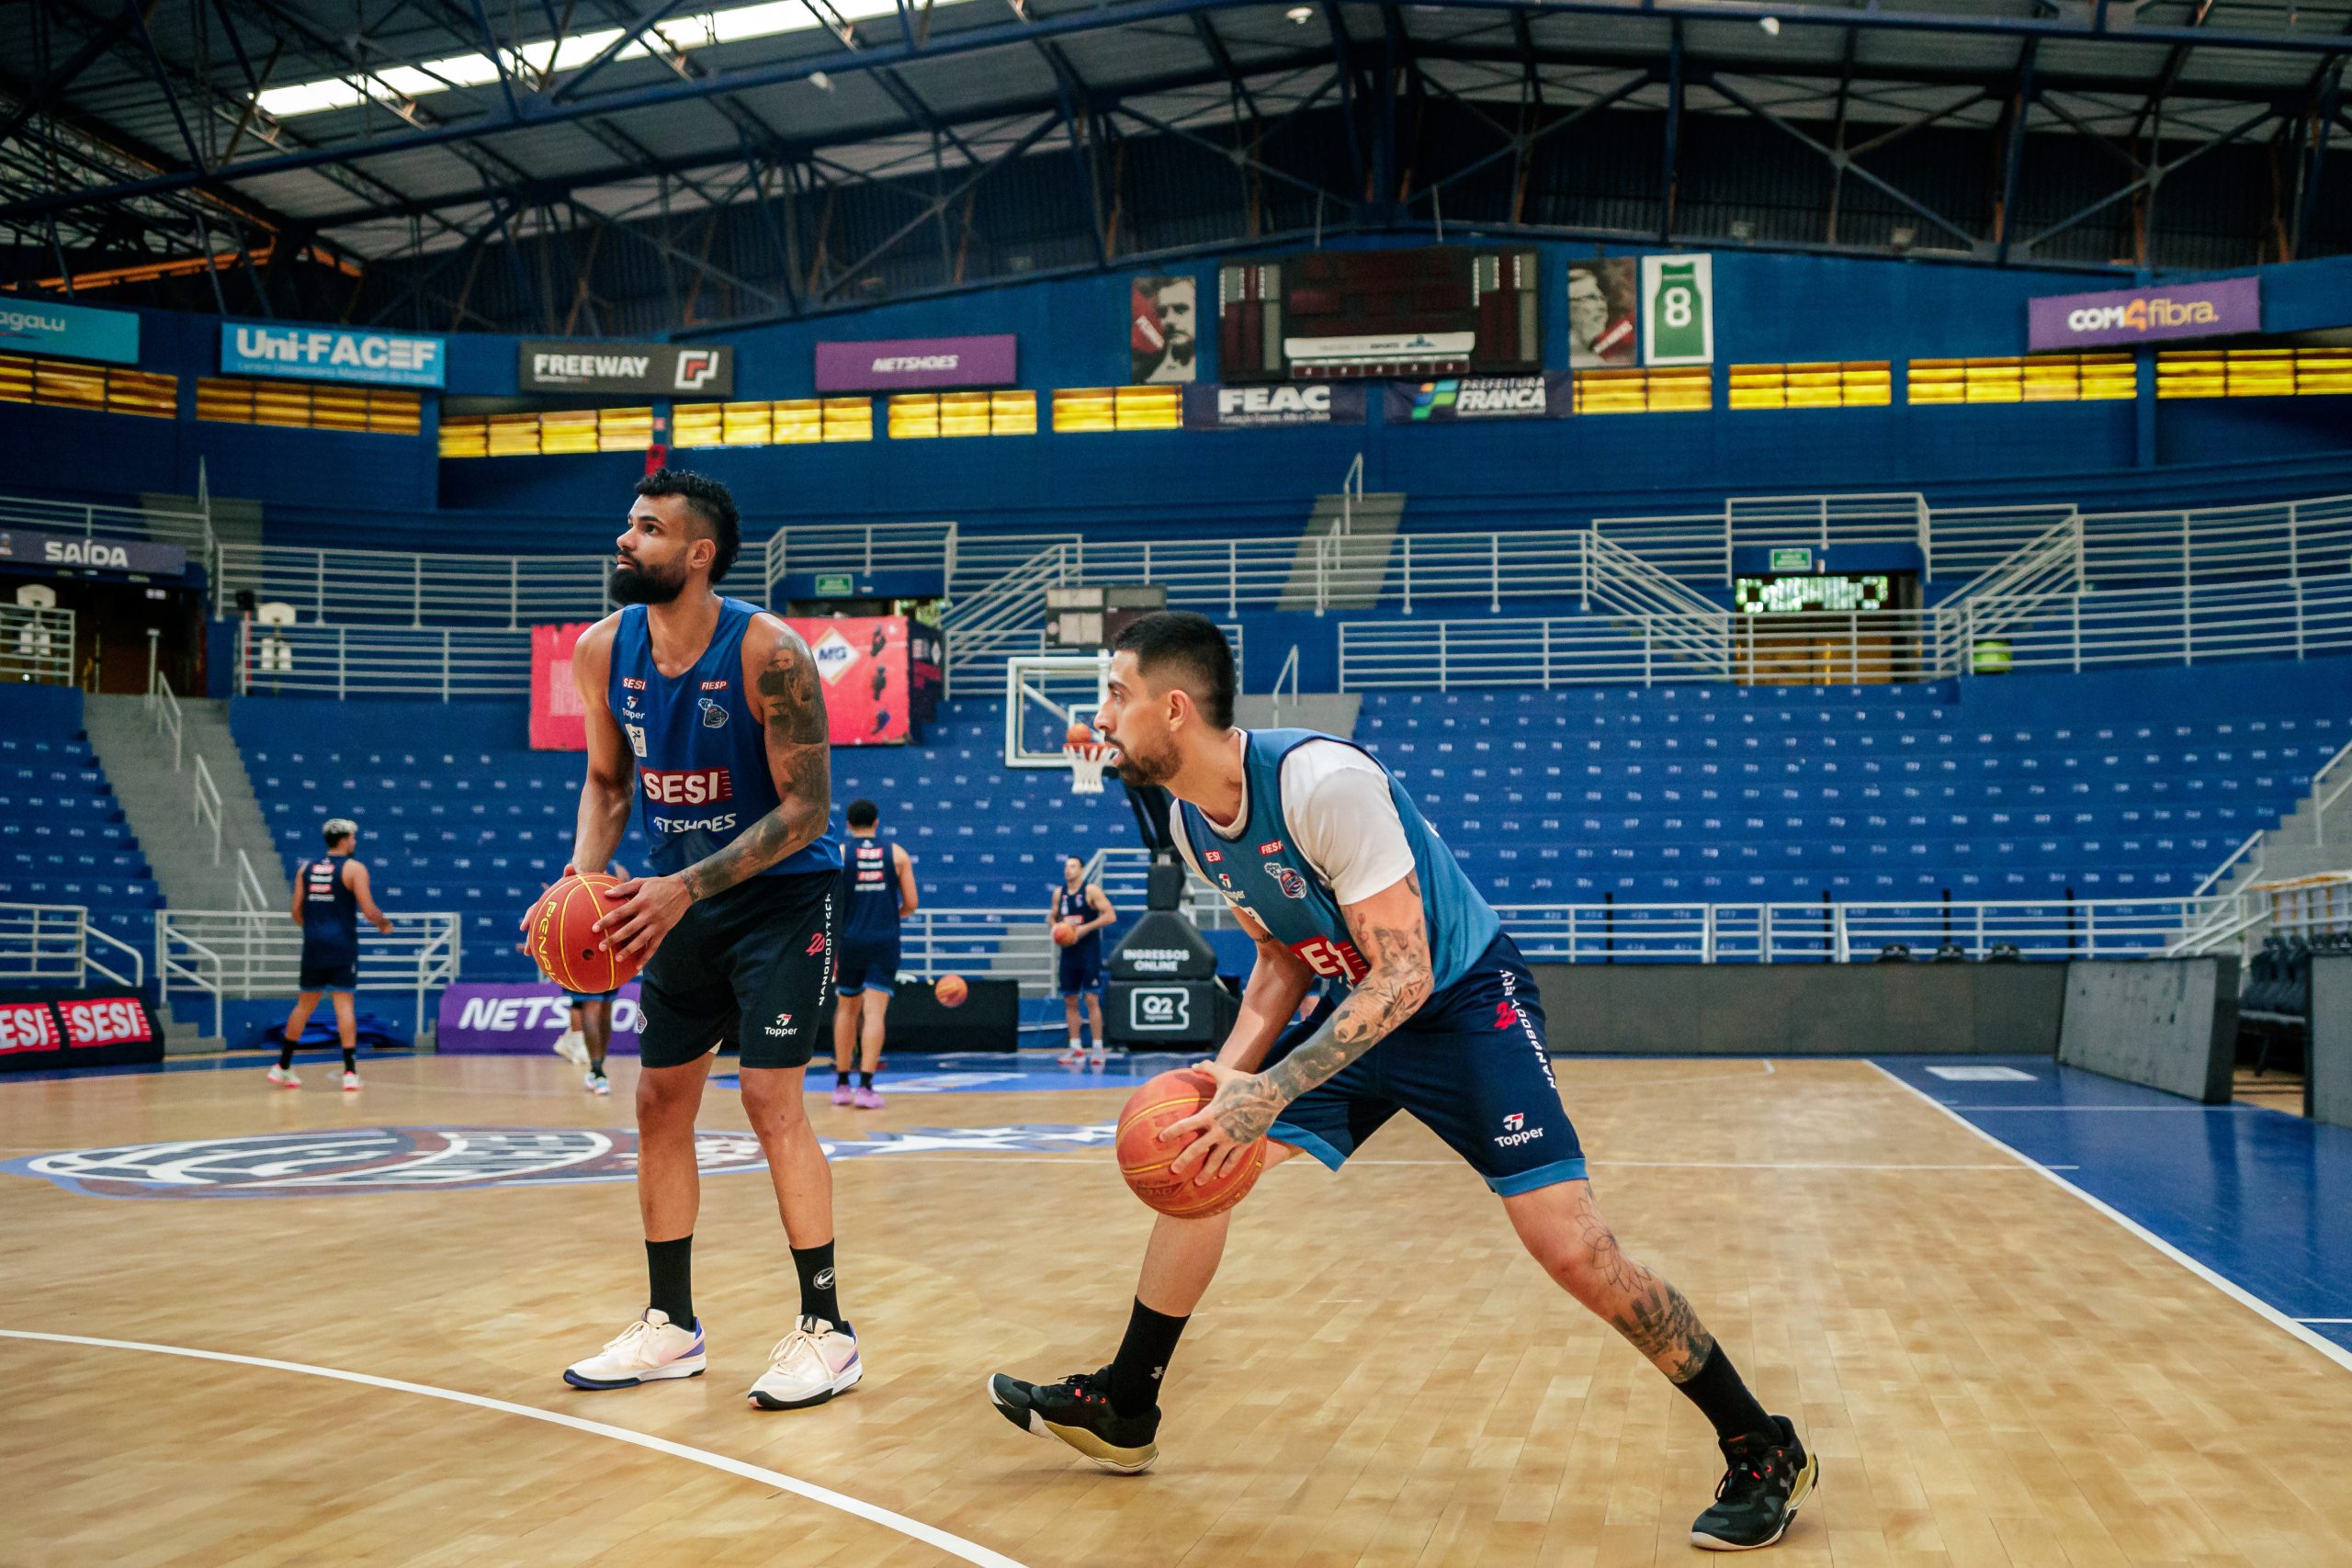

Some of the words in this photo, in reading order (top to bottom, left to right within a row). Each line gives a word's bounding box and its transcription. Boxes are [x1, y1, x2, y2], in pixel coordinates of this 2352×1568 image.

[1664, 287, 1692, 328] 8
[236, 328, 436, 371] Uni-FACEF
[534, 353, 650, 378] FREEWAY
[871, 355, 959, 373] NETSHOES
[1218, 385, 1331, 413] FEAC
[1455, 387, 1546, 411] FRANCA
[45, 538, 129, 569] SAÍDA
[623, 678, 646, 691] SESI
[701, 681, 727, 691] FIESP
[643, 773, 718, 804] SESI
[1123, 949, 1190, 962] INGRESSOS
[1134, 961, 1178, 972] ONLINE
[459, 996, 639, 1032] NETSO
[1142, 995, 1174, 1015] Q2
[71, 1001, 141, 1043] SESI
[764, 1026, 797, 1037] Topper
[1494, 1127, 1544, 1147] Topper
